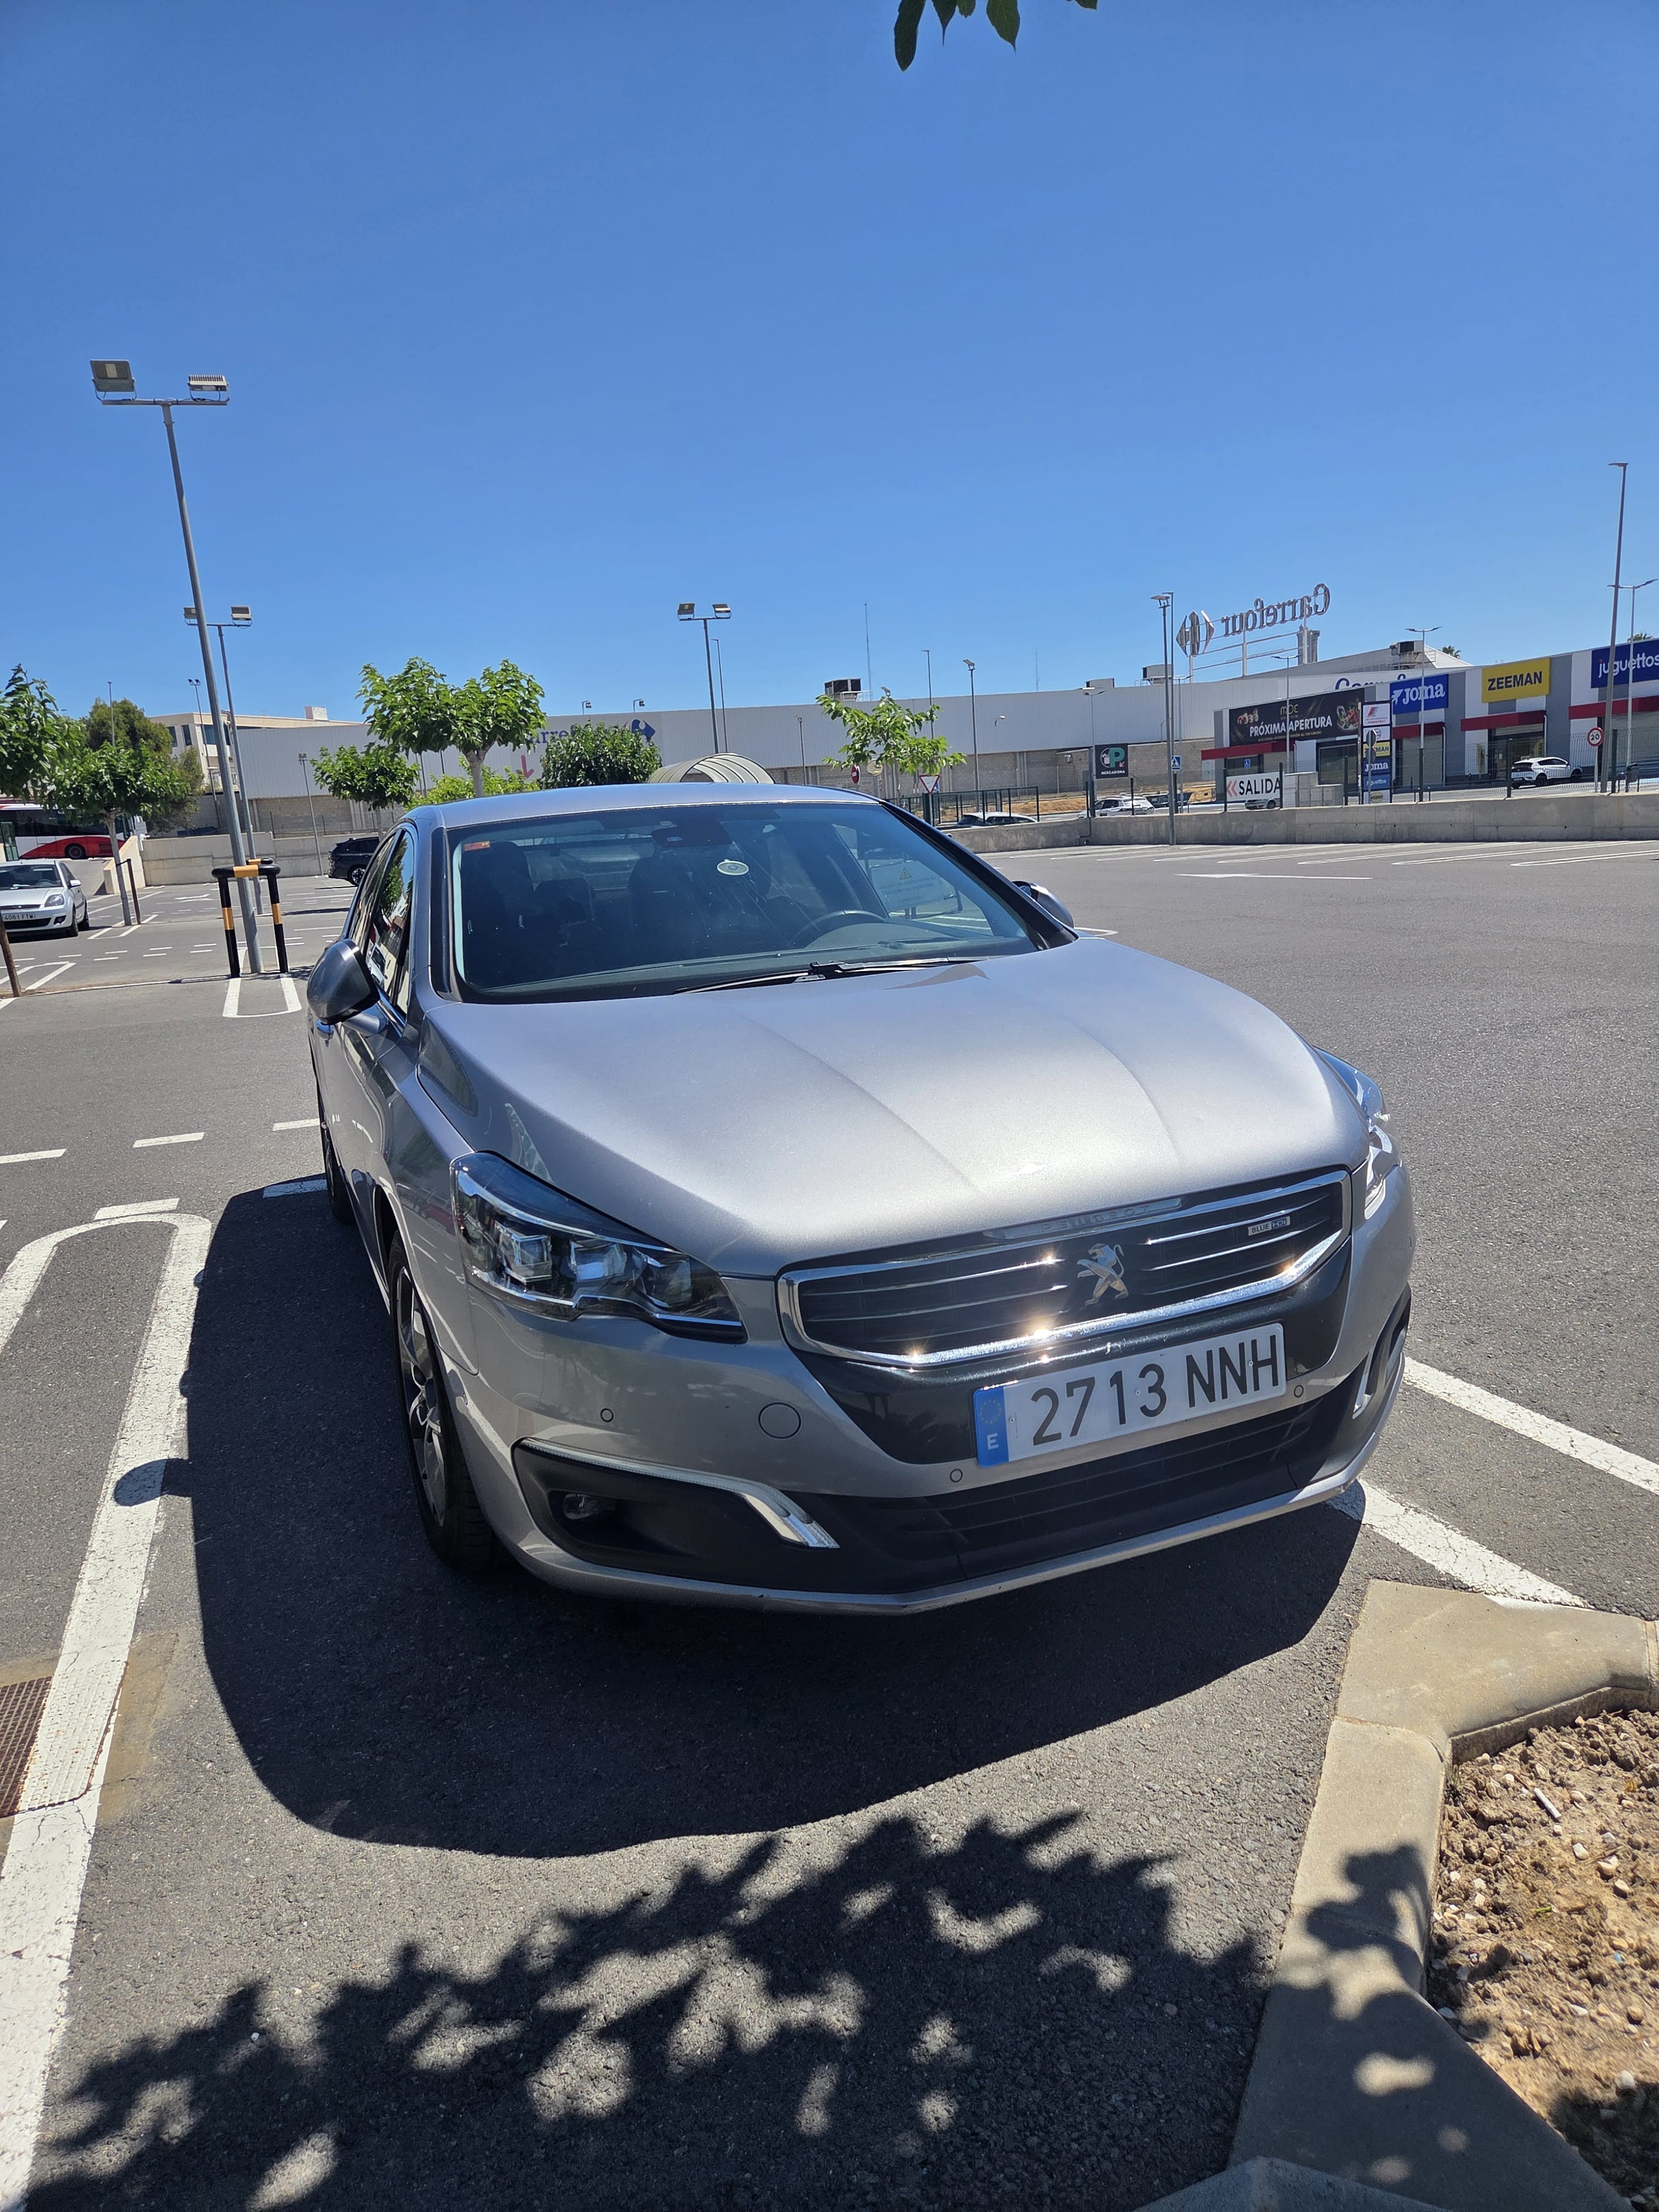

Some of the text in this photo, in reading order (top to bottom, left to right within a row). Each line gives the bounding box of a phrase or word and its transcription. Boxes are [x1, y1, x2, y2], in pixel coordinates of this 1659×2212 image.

[1488, 671, 1542, 691] ZEEMAN
[1249, 721, 1286, 737] PRÓXIMA
[1288, 716, 1332, 732] APERTURA
[1109, 747, 1125, 768] P
[1239, 777, 1280, 795] SALIDA
[1041, 1206, 1150, 1231] PEUGEOT
[1251, 1223, 1269, 1233] BLUE
[1030, 1334, 1279, 1446] 2713 NNH
[987, 1433, 999, 1450] E
